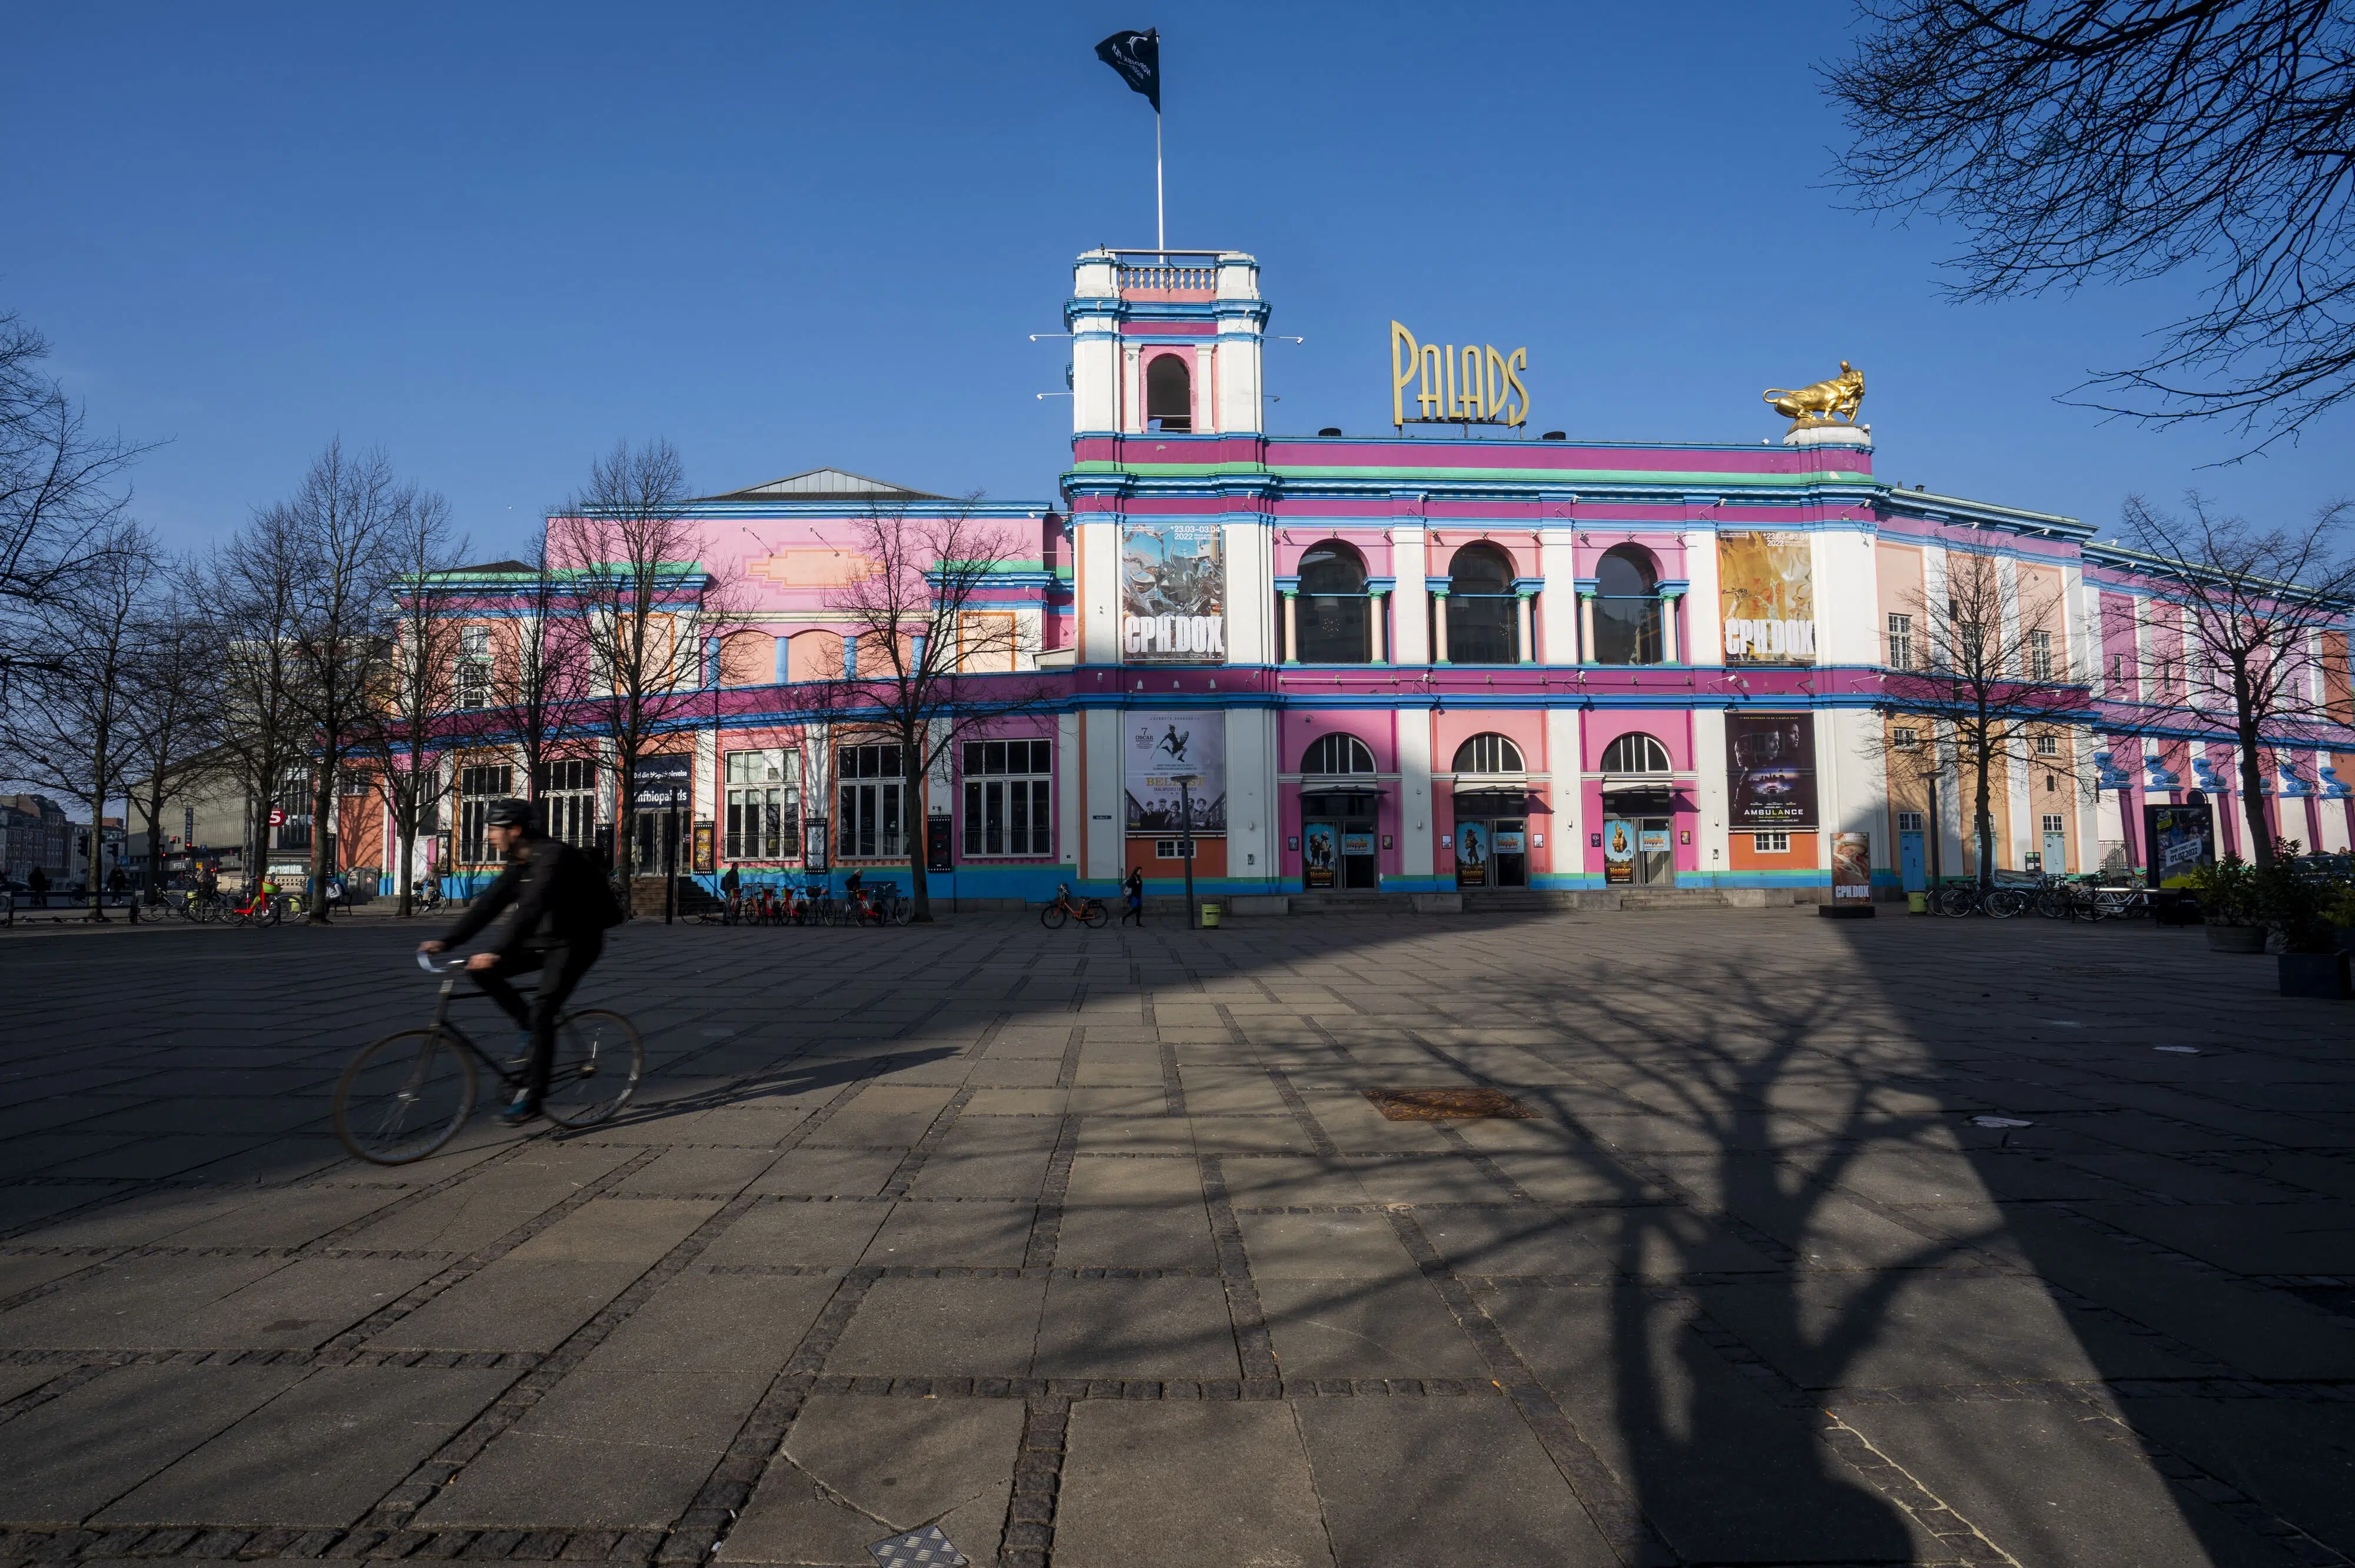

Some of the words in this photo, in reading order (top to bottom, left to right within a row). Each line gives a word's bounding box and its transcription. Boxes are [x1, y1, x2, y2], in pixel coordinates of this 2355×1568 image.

[1391, 320, 1529, 428] PALADS
[2170, 847, 2198, 862] 01.07.2022
[1610, 868, 1631, 876] Hopper
